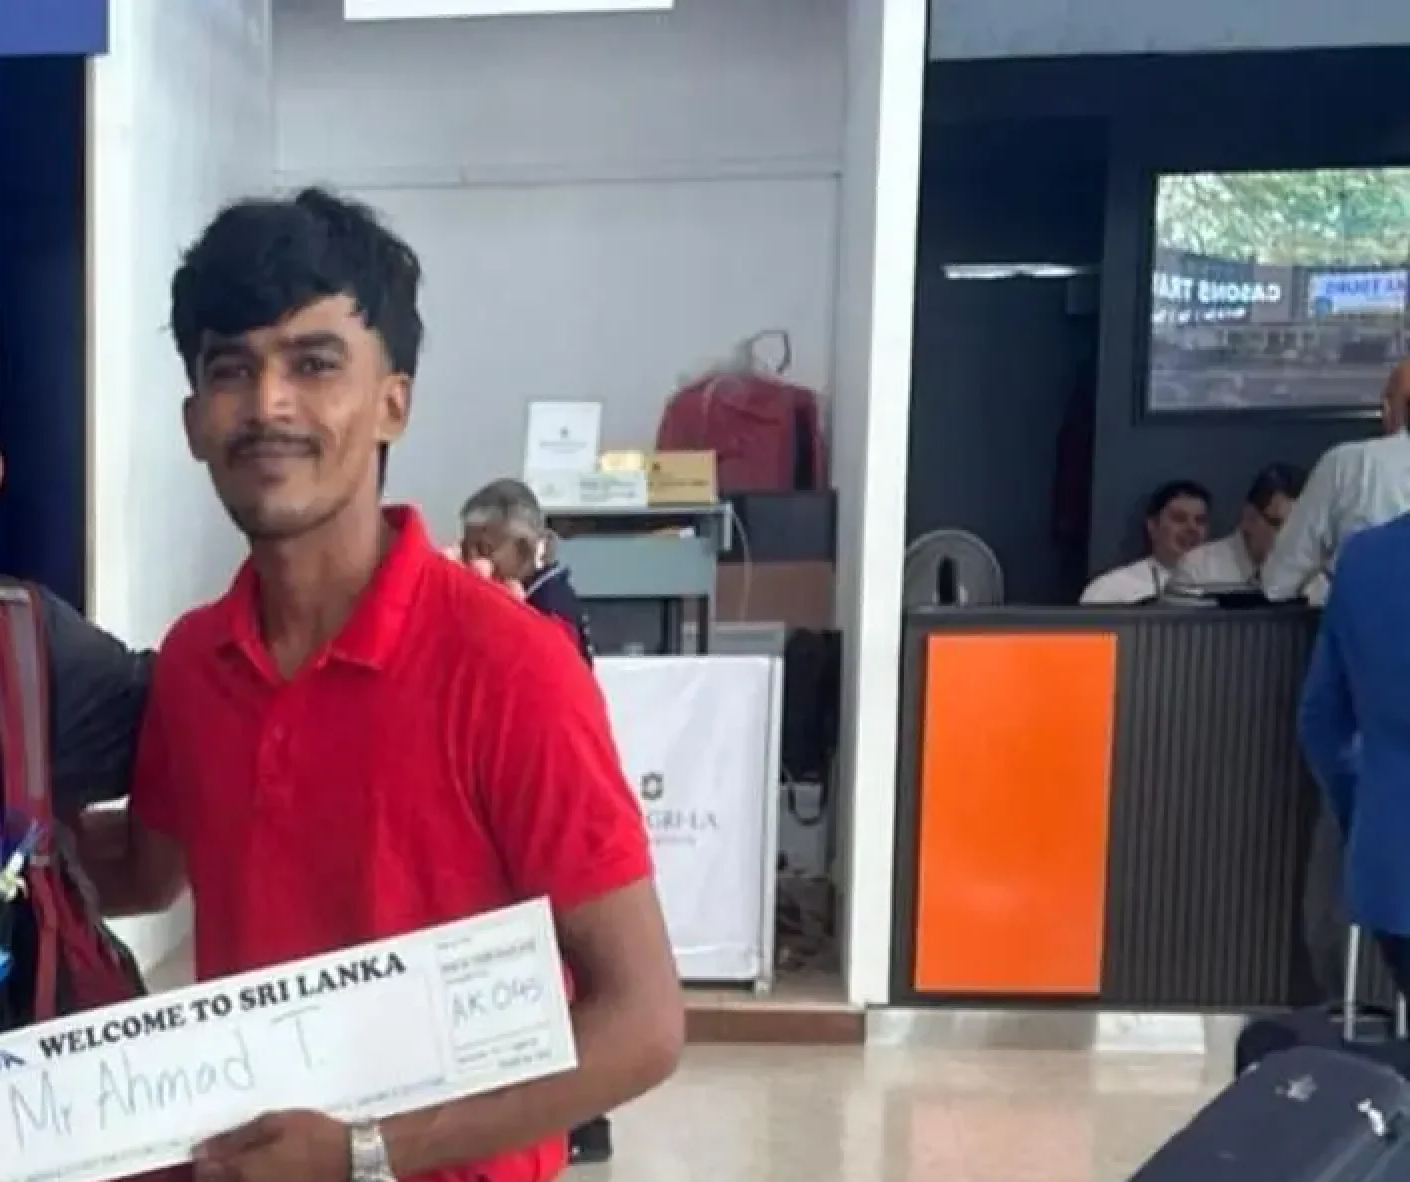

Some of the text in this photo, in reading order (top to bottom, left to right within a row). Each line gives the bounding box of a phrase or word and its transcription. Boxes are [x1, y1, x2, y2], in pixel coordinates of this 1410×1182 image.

[38, 1002, 186, 1058] WELCOME
[190, 993, 233, 1023] TO
[238, 979, 290, 1012] SRI
[295, 951, 407, 998] LANKA
[8, 1070, 72, 1152] Mr
[97, 1024, 256, 1131] Ahmad
